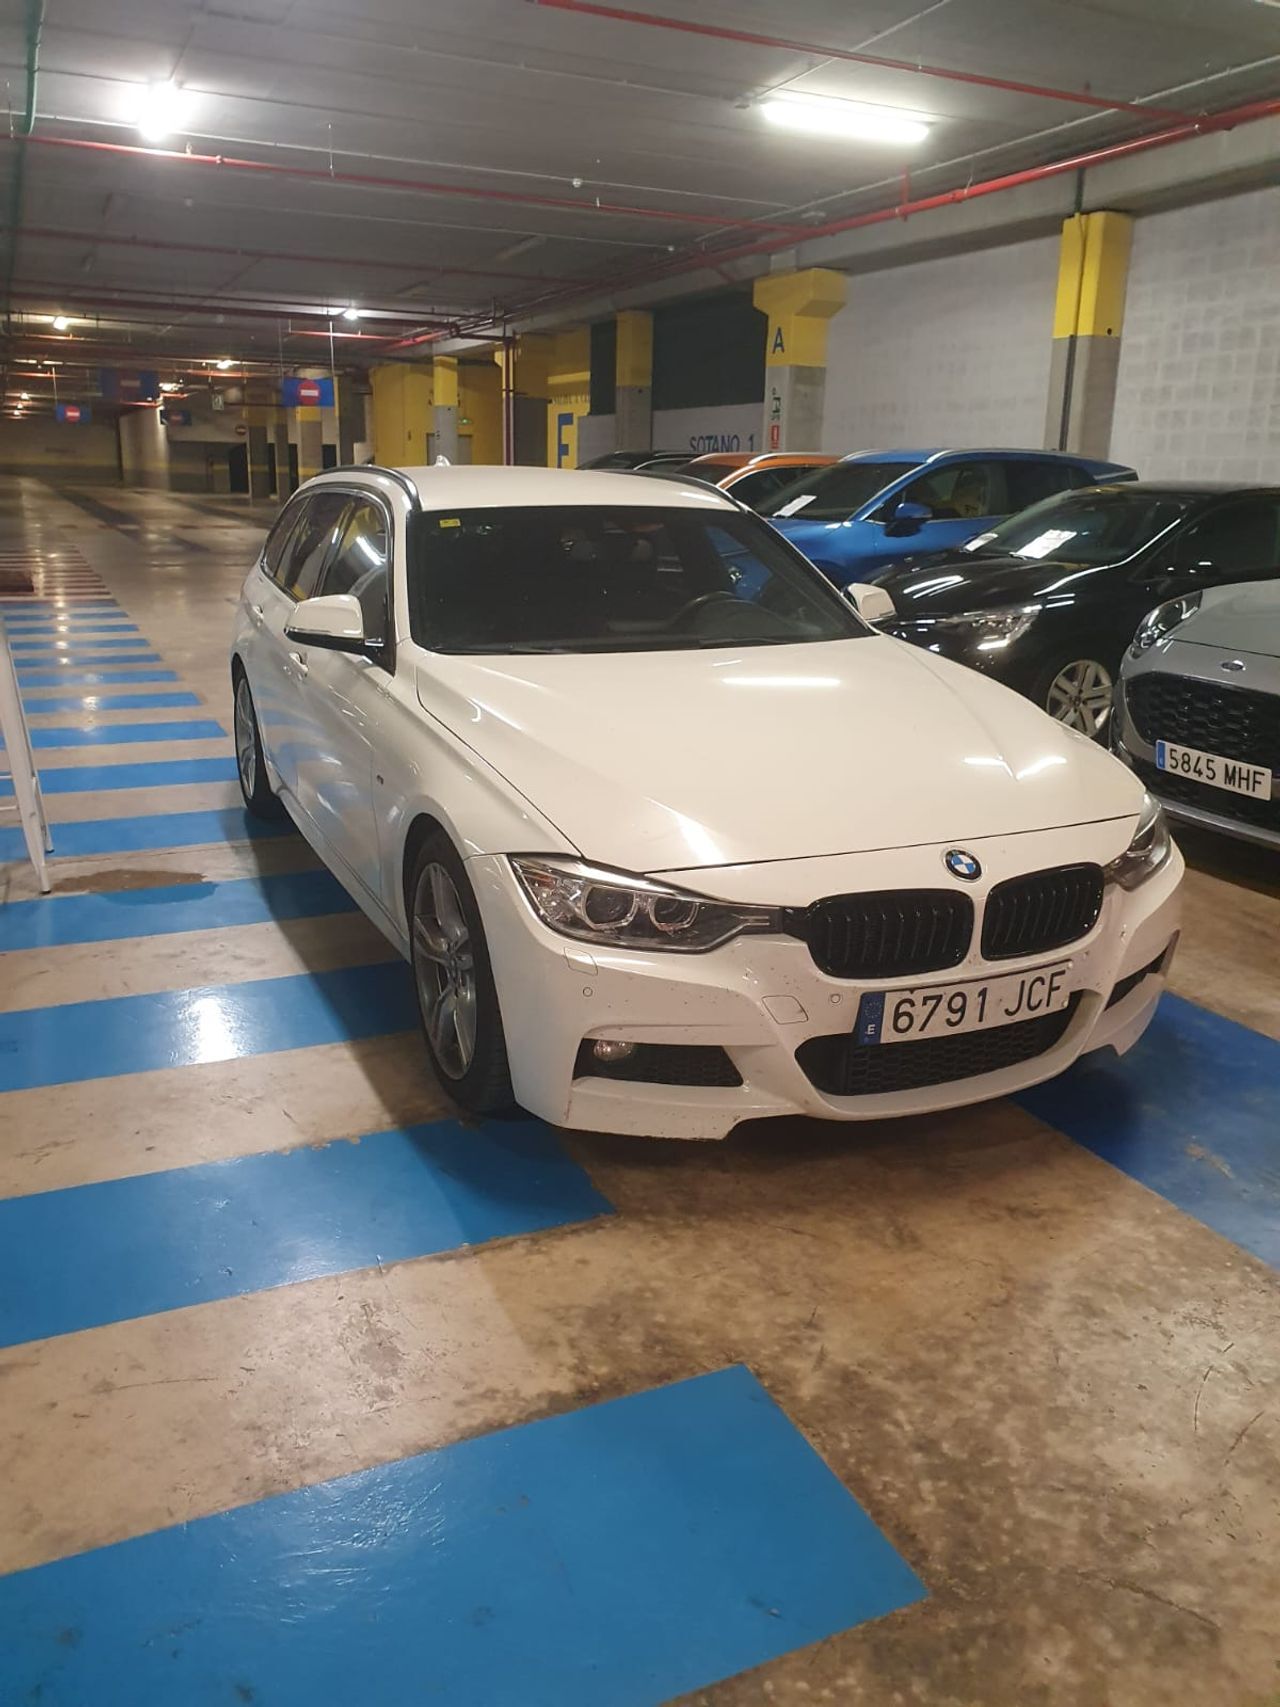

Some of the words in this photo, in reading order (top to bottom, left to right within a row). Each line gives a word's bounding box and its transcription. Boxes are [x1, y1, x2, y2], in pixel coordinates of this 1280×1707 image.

[772, 326, 785, 354] A
[1169, 747, 1216, 781] 5845
[1224, 763, 1265, 793] MHF
[892, 986, 988, 1034] 6791
[1004, 969, 1066, 1017] JCF
[866, 1023, 876, 1035] E
